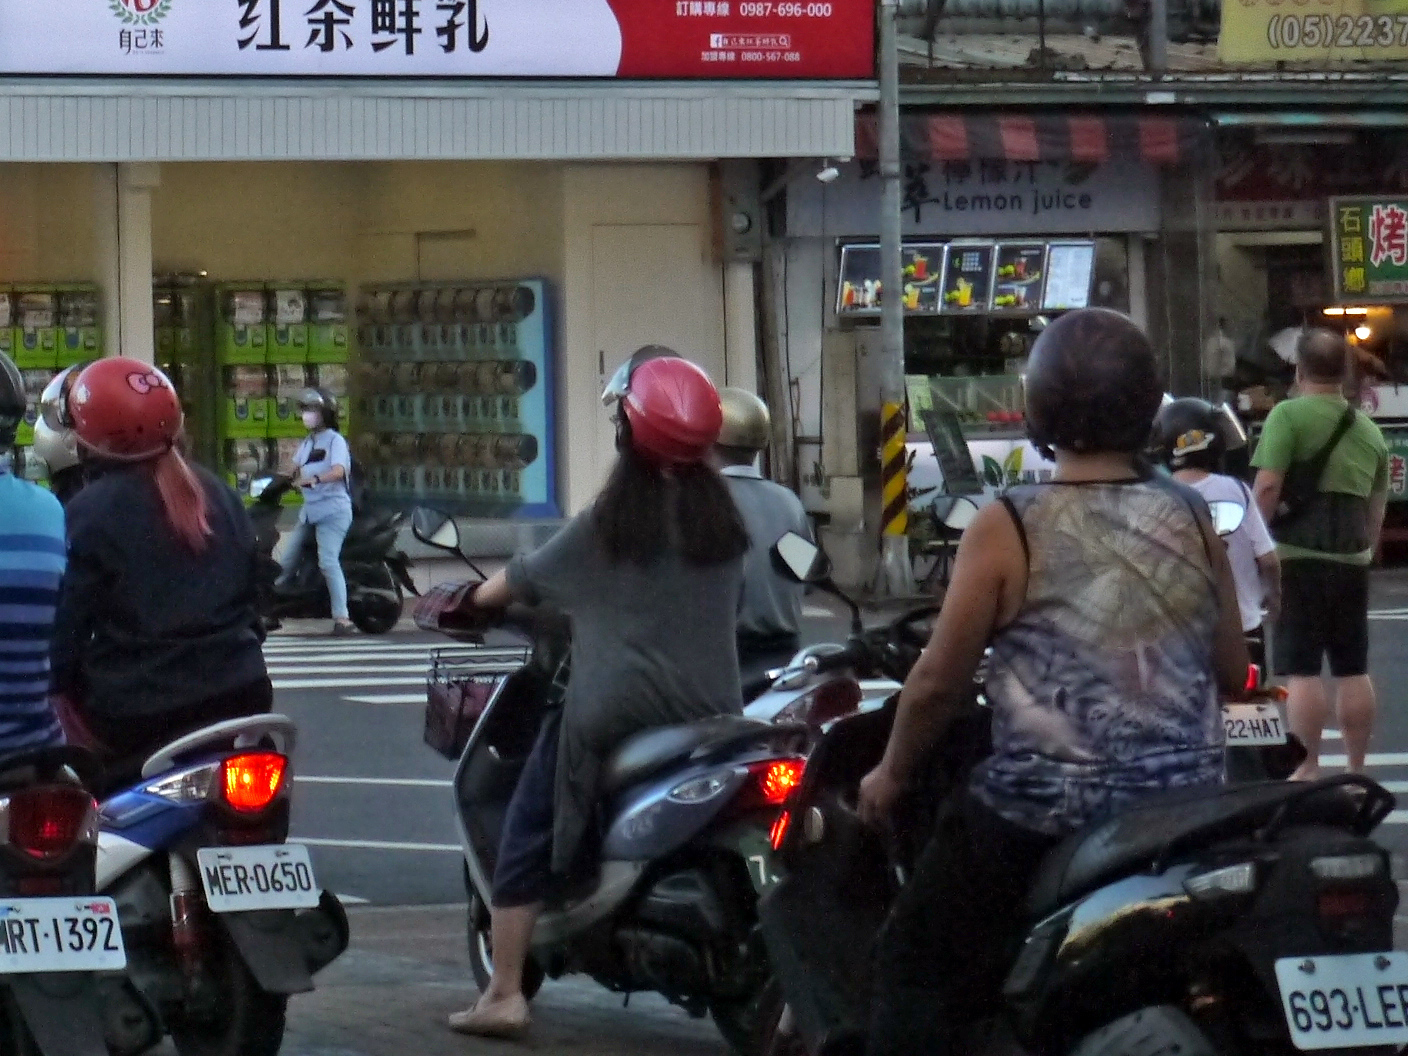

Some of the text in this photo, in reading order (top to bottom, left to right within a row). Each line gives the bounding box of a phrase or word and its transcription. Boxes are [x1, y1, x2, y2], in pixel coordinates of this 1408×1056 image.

[676, 1, 832, 18] 訂購專線 0987-696-000
[945, 190, 1091, 215] Lemon juice
[205, 860, 312, 898] MER-0650
